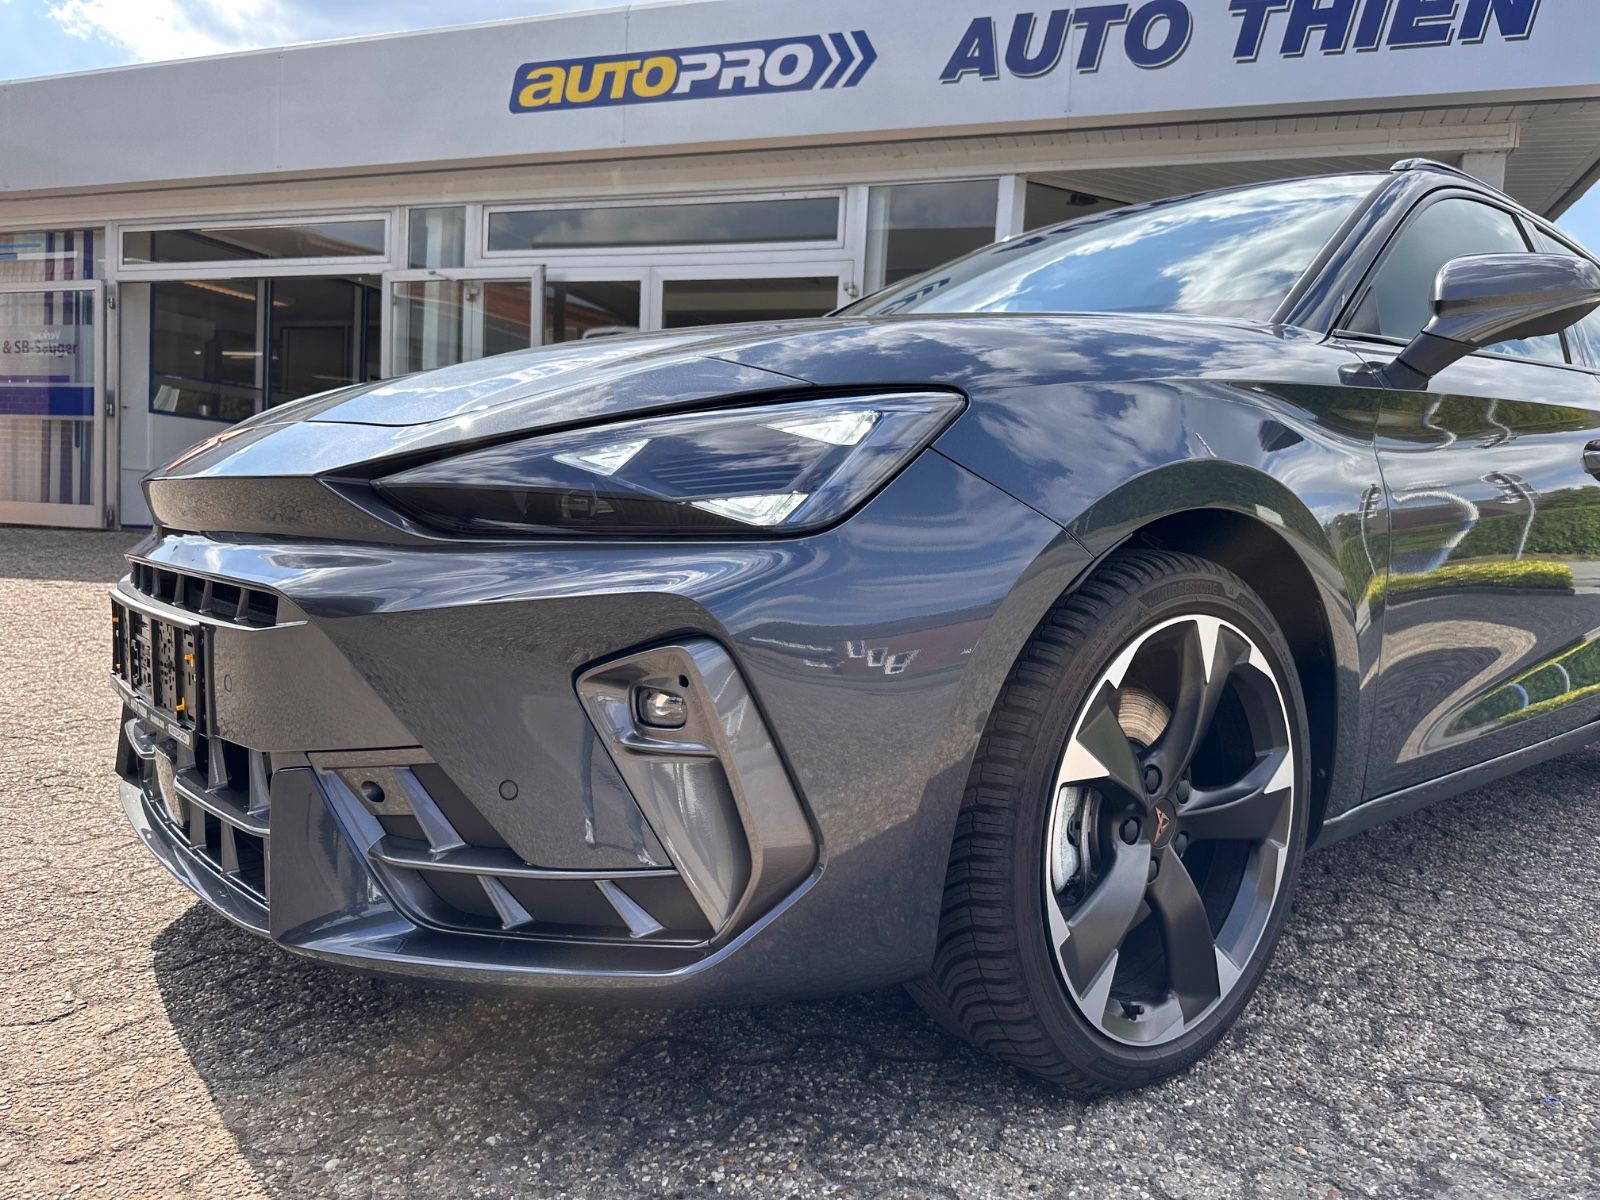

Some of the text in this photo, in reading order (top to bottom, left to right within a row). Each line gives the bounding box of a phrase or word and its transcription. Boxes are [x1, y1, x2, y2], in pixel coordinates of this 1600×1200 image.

[938, 0, 1542, 84] AUTO THIEN
[2, 340, 12, 354] &
